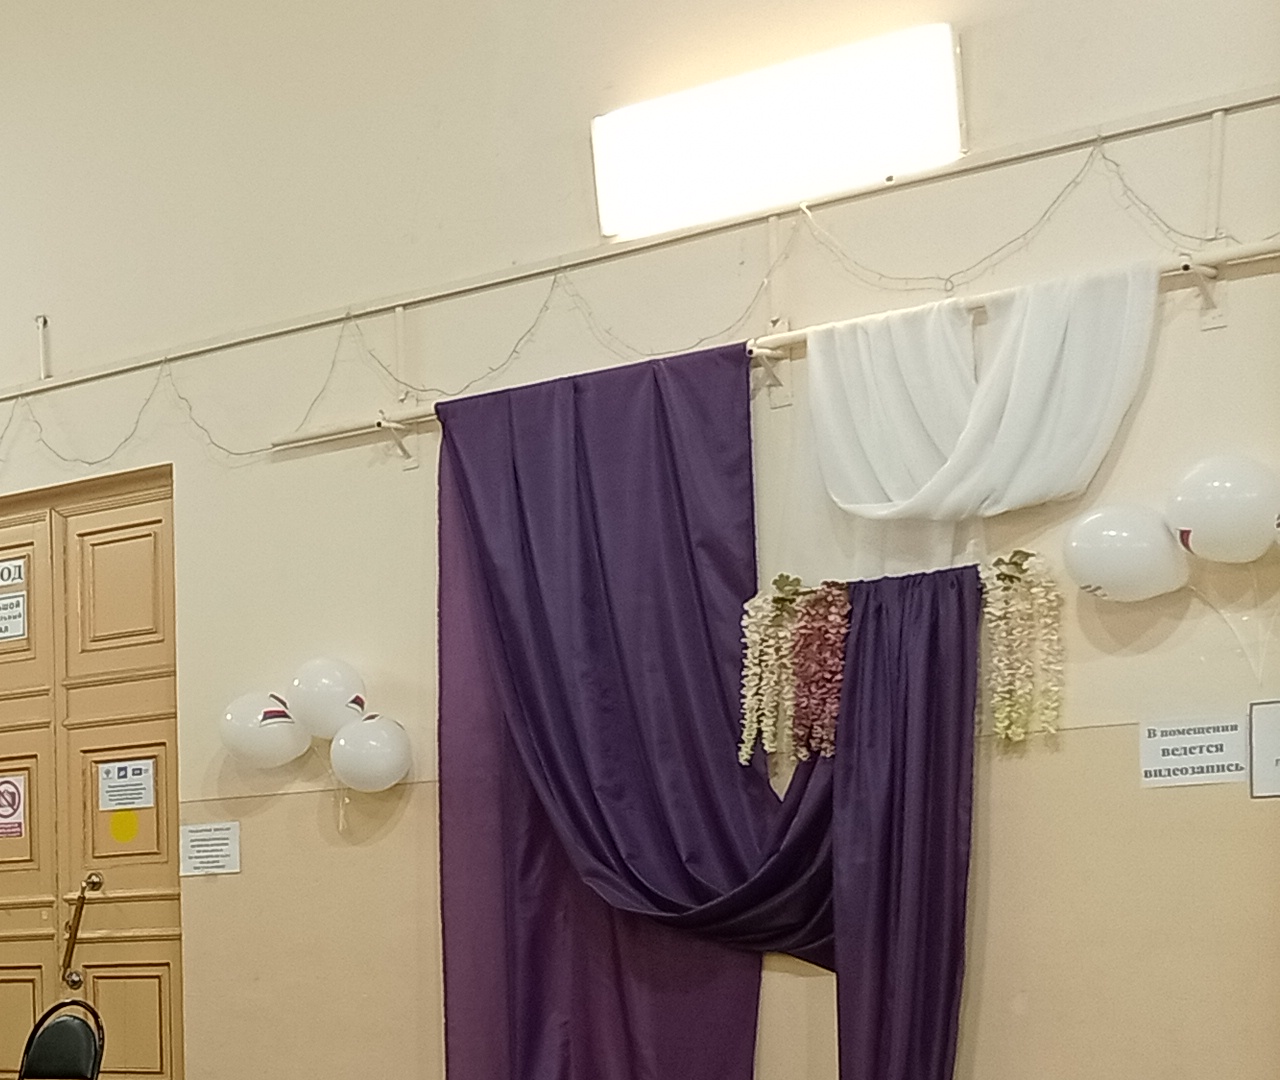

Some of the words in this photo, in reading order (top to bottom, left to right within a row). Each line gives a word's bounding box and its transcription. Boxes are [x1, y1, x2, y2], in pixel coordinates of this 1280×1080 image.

[1147, 728, 1157, 738] В
[1160, 724, 1239, 738] помещении
[1161, 743, 1224, 757] ведется
[1144, 763, 1245, 778] видеозапись
